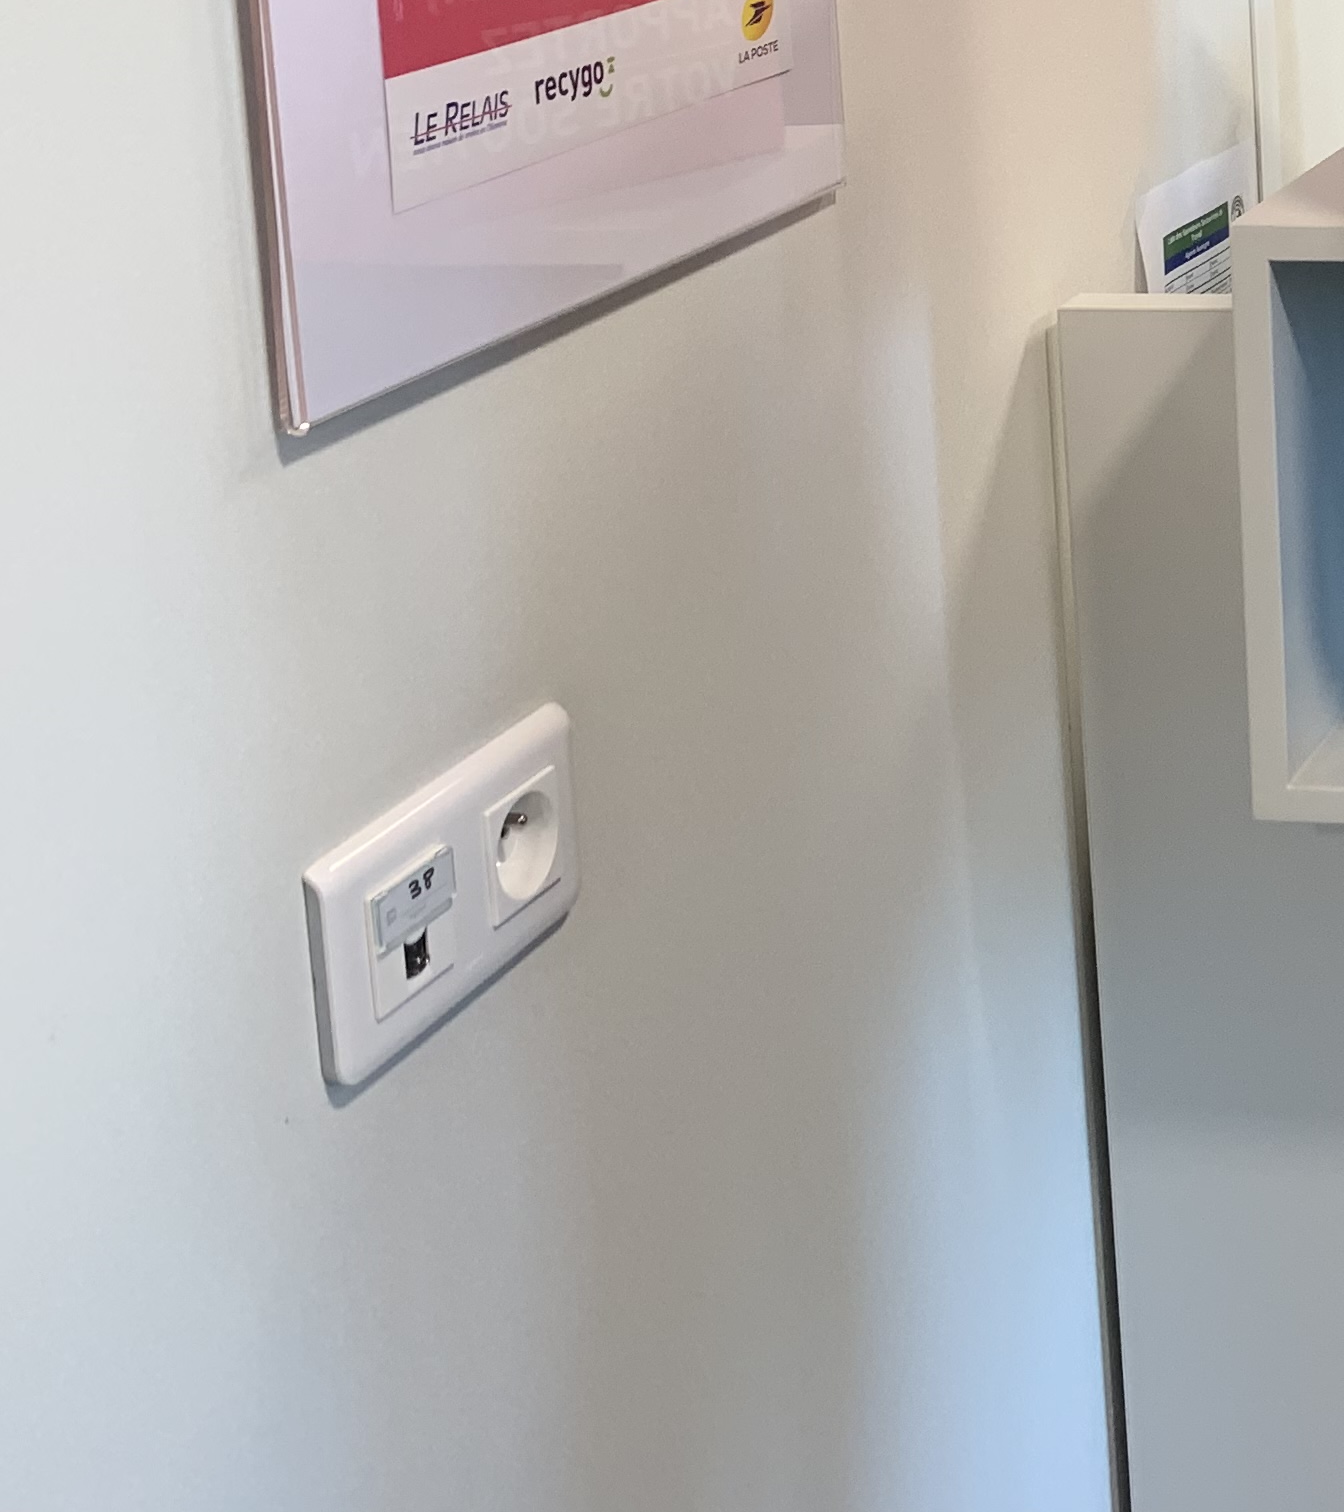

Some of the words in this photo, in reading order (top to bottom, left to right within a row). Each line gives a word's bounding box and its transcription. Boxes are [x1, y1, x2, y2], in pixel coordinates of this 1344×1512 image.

[738, 48, 754, 65] LA
[753, 38, 780, 61] POSTE
[534, 59, 605, 106] recygo
[413, 111, 439, 148] LE
[444, 90, 512, 137] RELAIS
[408, 866, 435, 900] 38
